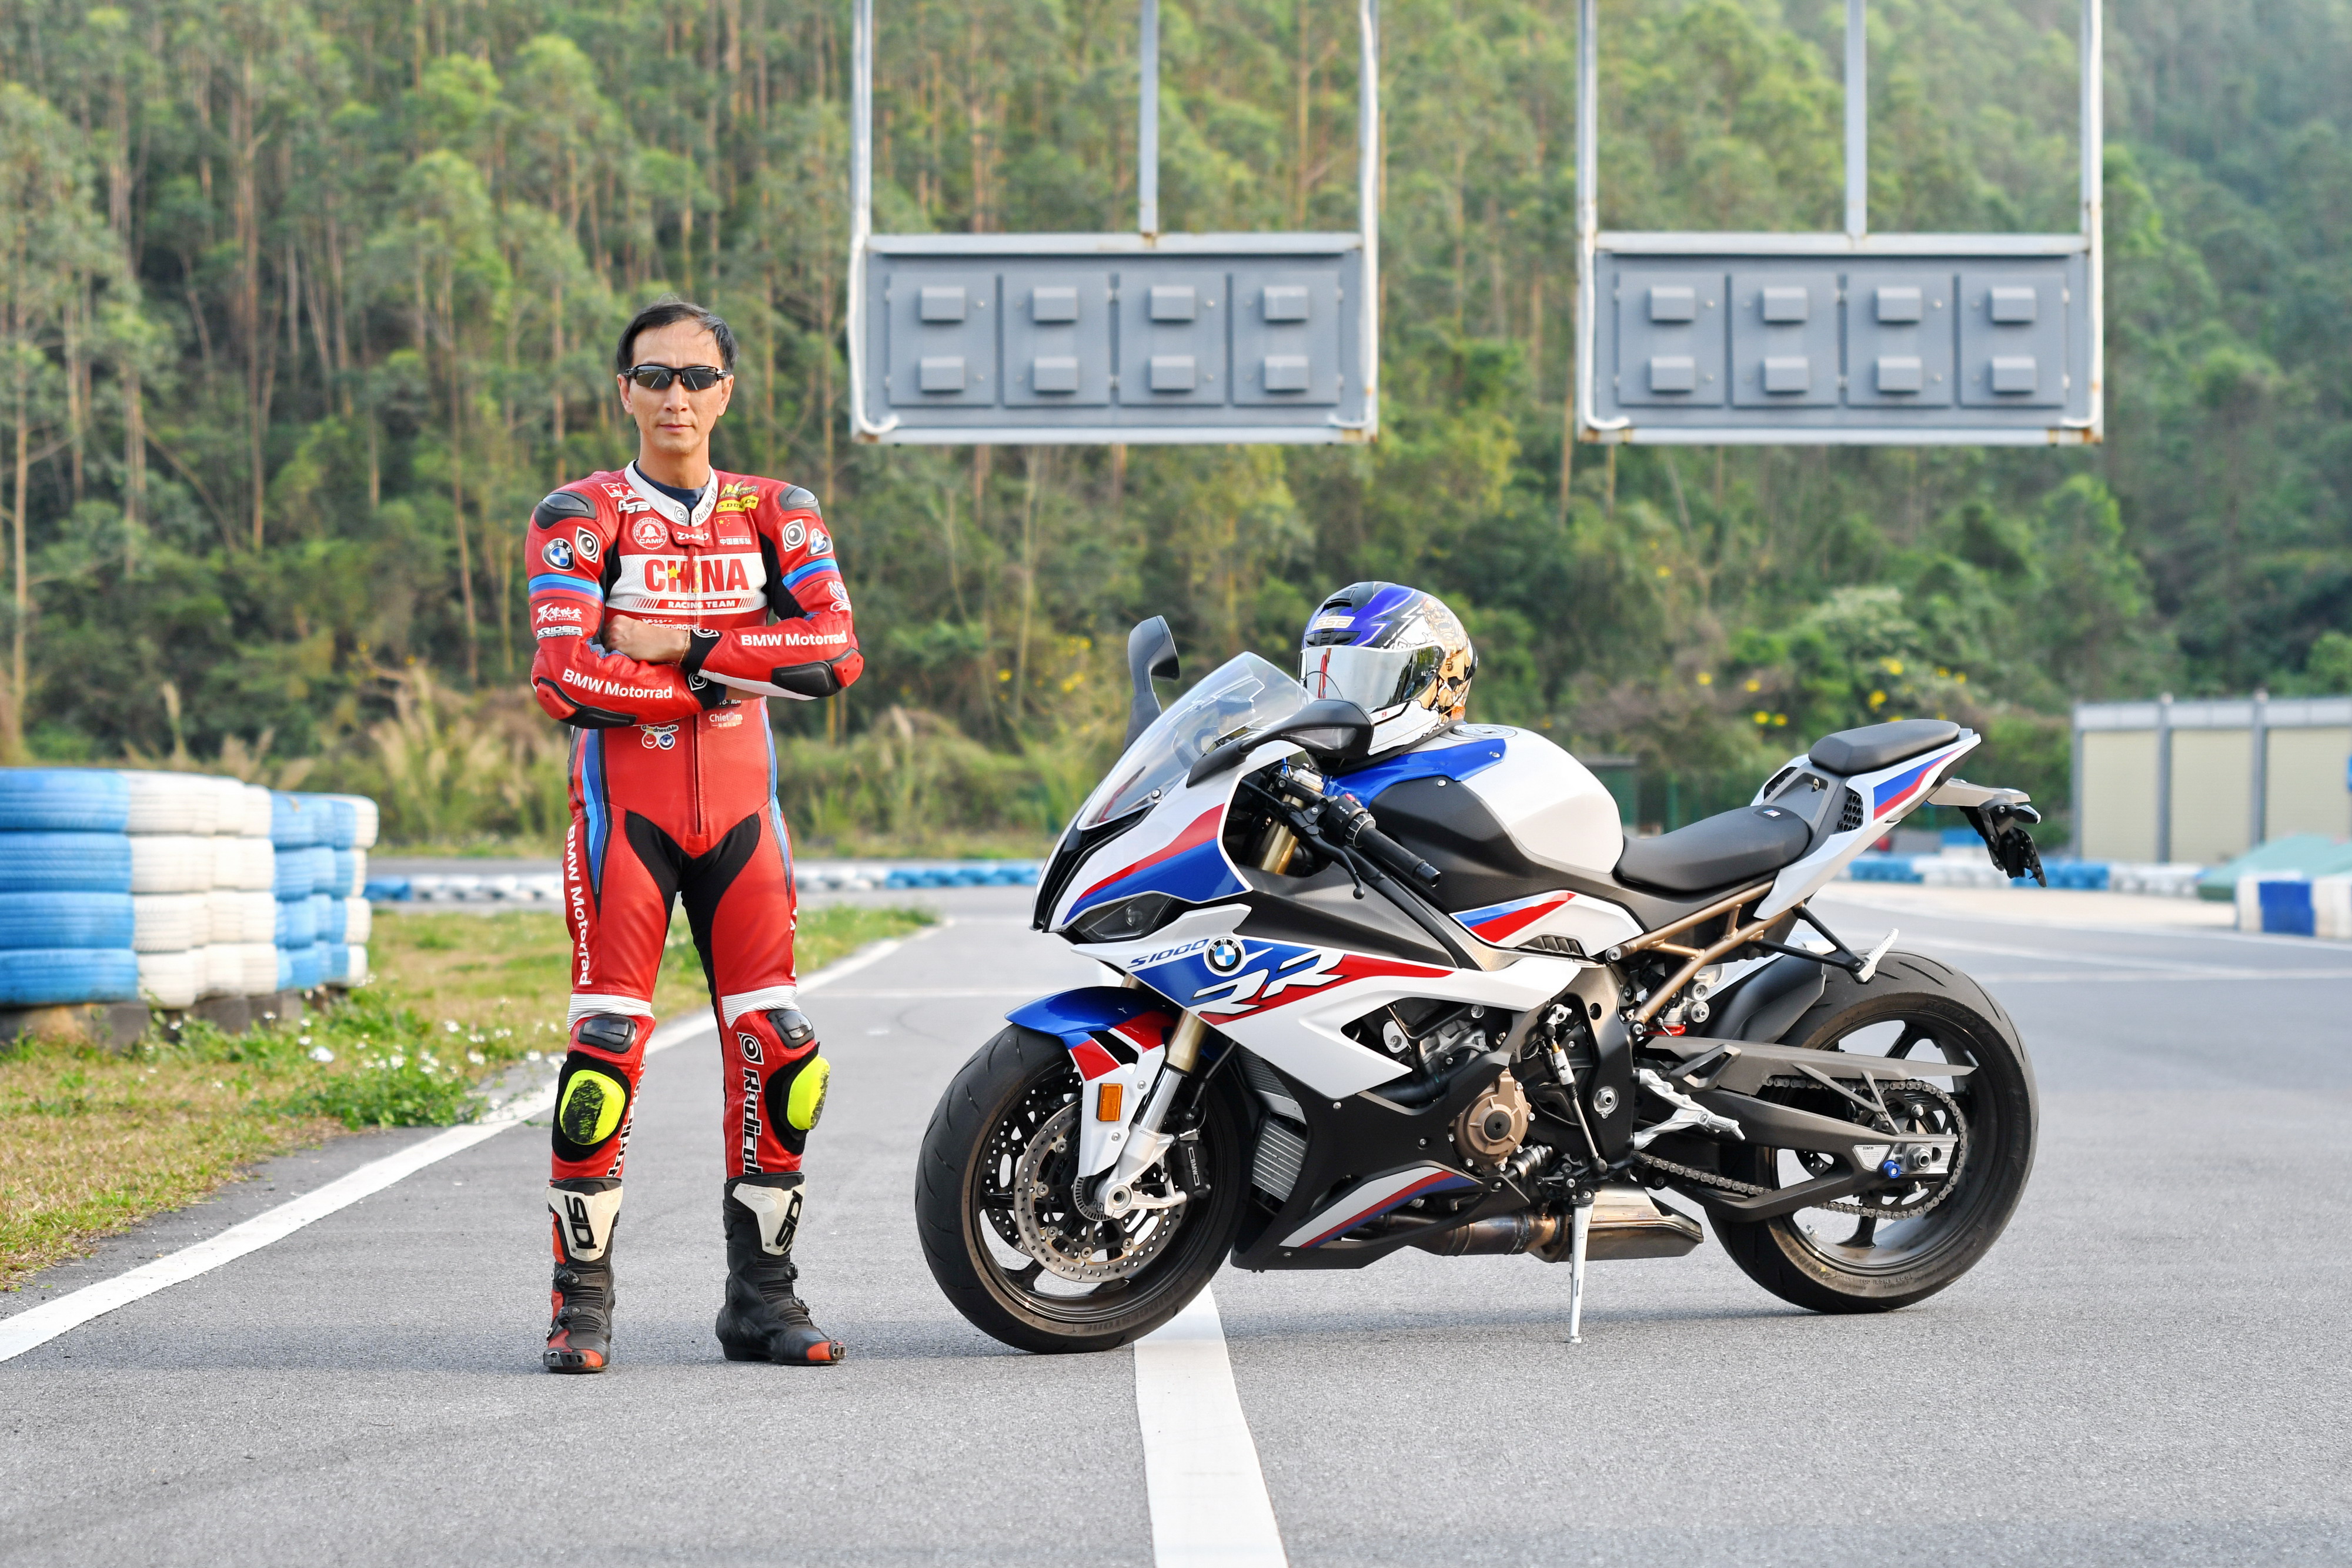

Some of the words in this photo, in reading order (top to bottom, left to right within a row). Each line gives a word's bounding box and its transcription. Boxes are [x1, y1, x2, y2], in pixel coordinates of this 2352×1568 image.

[677, 531, 709, 540] ZHAO
[548, 540, 572, 554] BMW
[644, 559, 750, 593] CHINA
[667, 600, 704, 609] RACING
[706, 600, 736, 609] TEAM
[741, 633, 781, 646] BMW
[786, 631, 847, 646] Motorrad
[562, 669, 606, 692] BMW
[605, 683, 673, 699] Motorrad
[642, 724, 677, 733] GoodnessMe
[567, 825, 580, 881] BMW
[570, 886, 592, 985] Motorrad
[1211, 939, 1238, 951] BMW
[1127, 939, 1210, 969] S1000
[1190, 1158, 1199, 1176] BMW
